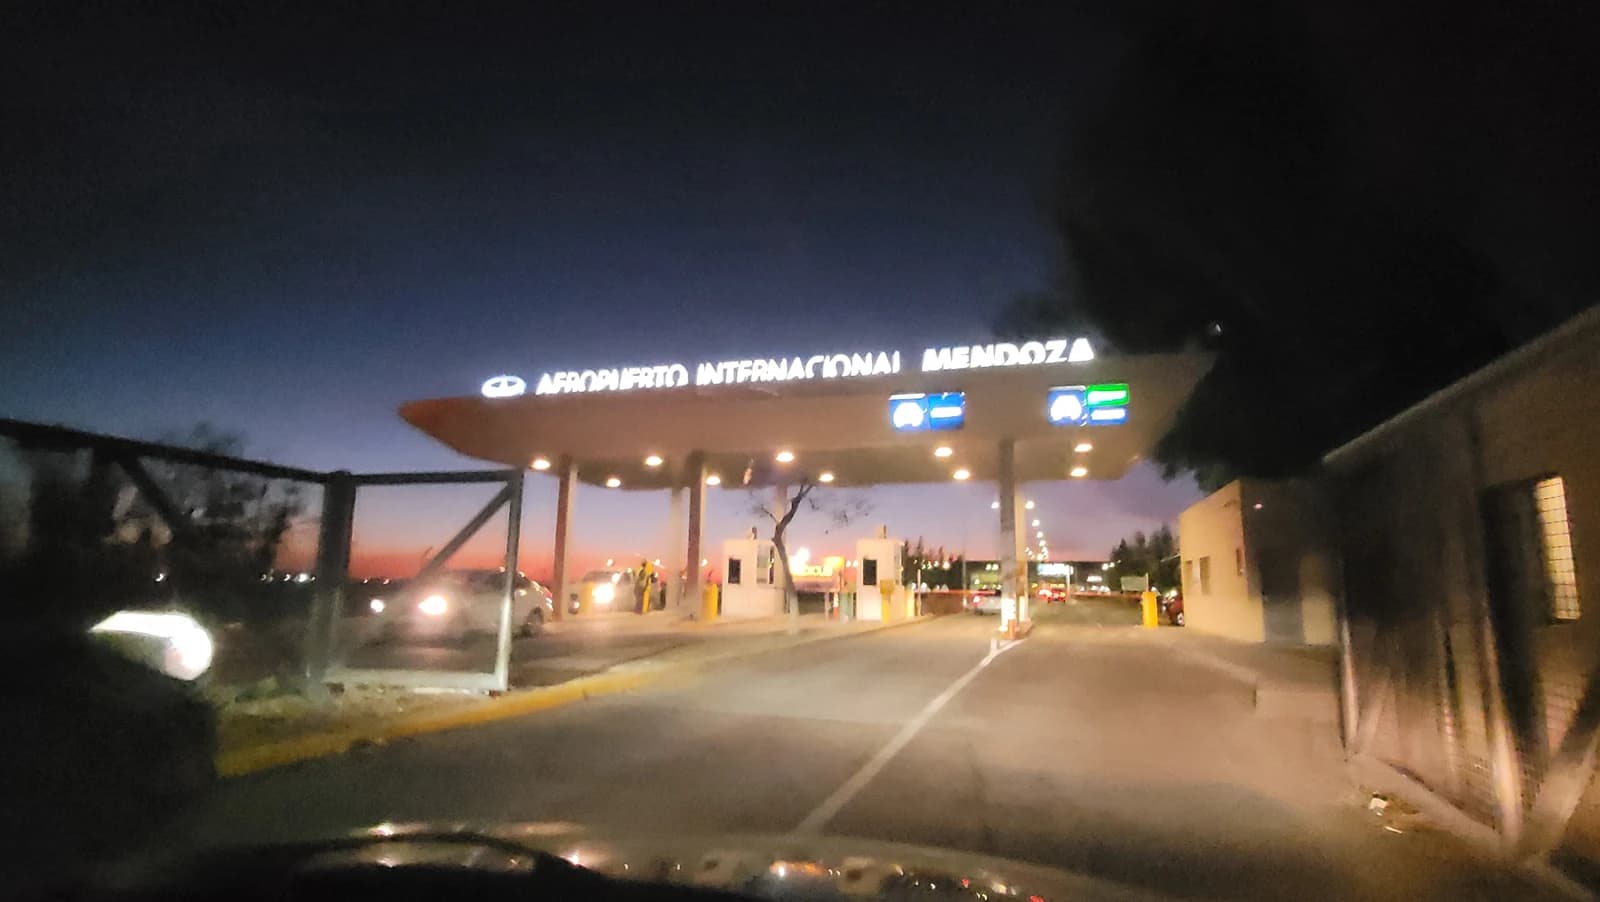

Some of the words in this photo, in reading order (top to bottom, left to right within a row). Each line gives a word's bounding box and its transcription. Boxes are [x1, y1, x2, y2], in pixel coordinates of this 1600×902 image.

[535, 363, 689, 395] AEROPUERTO
[695, 350, 901, 386] INTERNACIONAL
[921, 337, 1095, 372] MENDOZA
